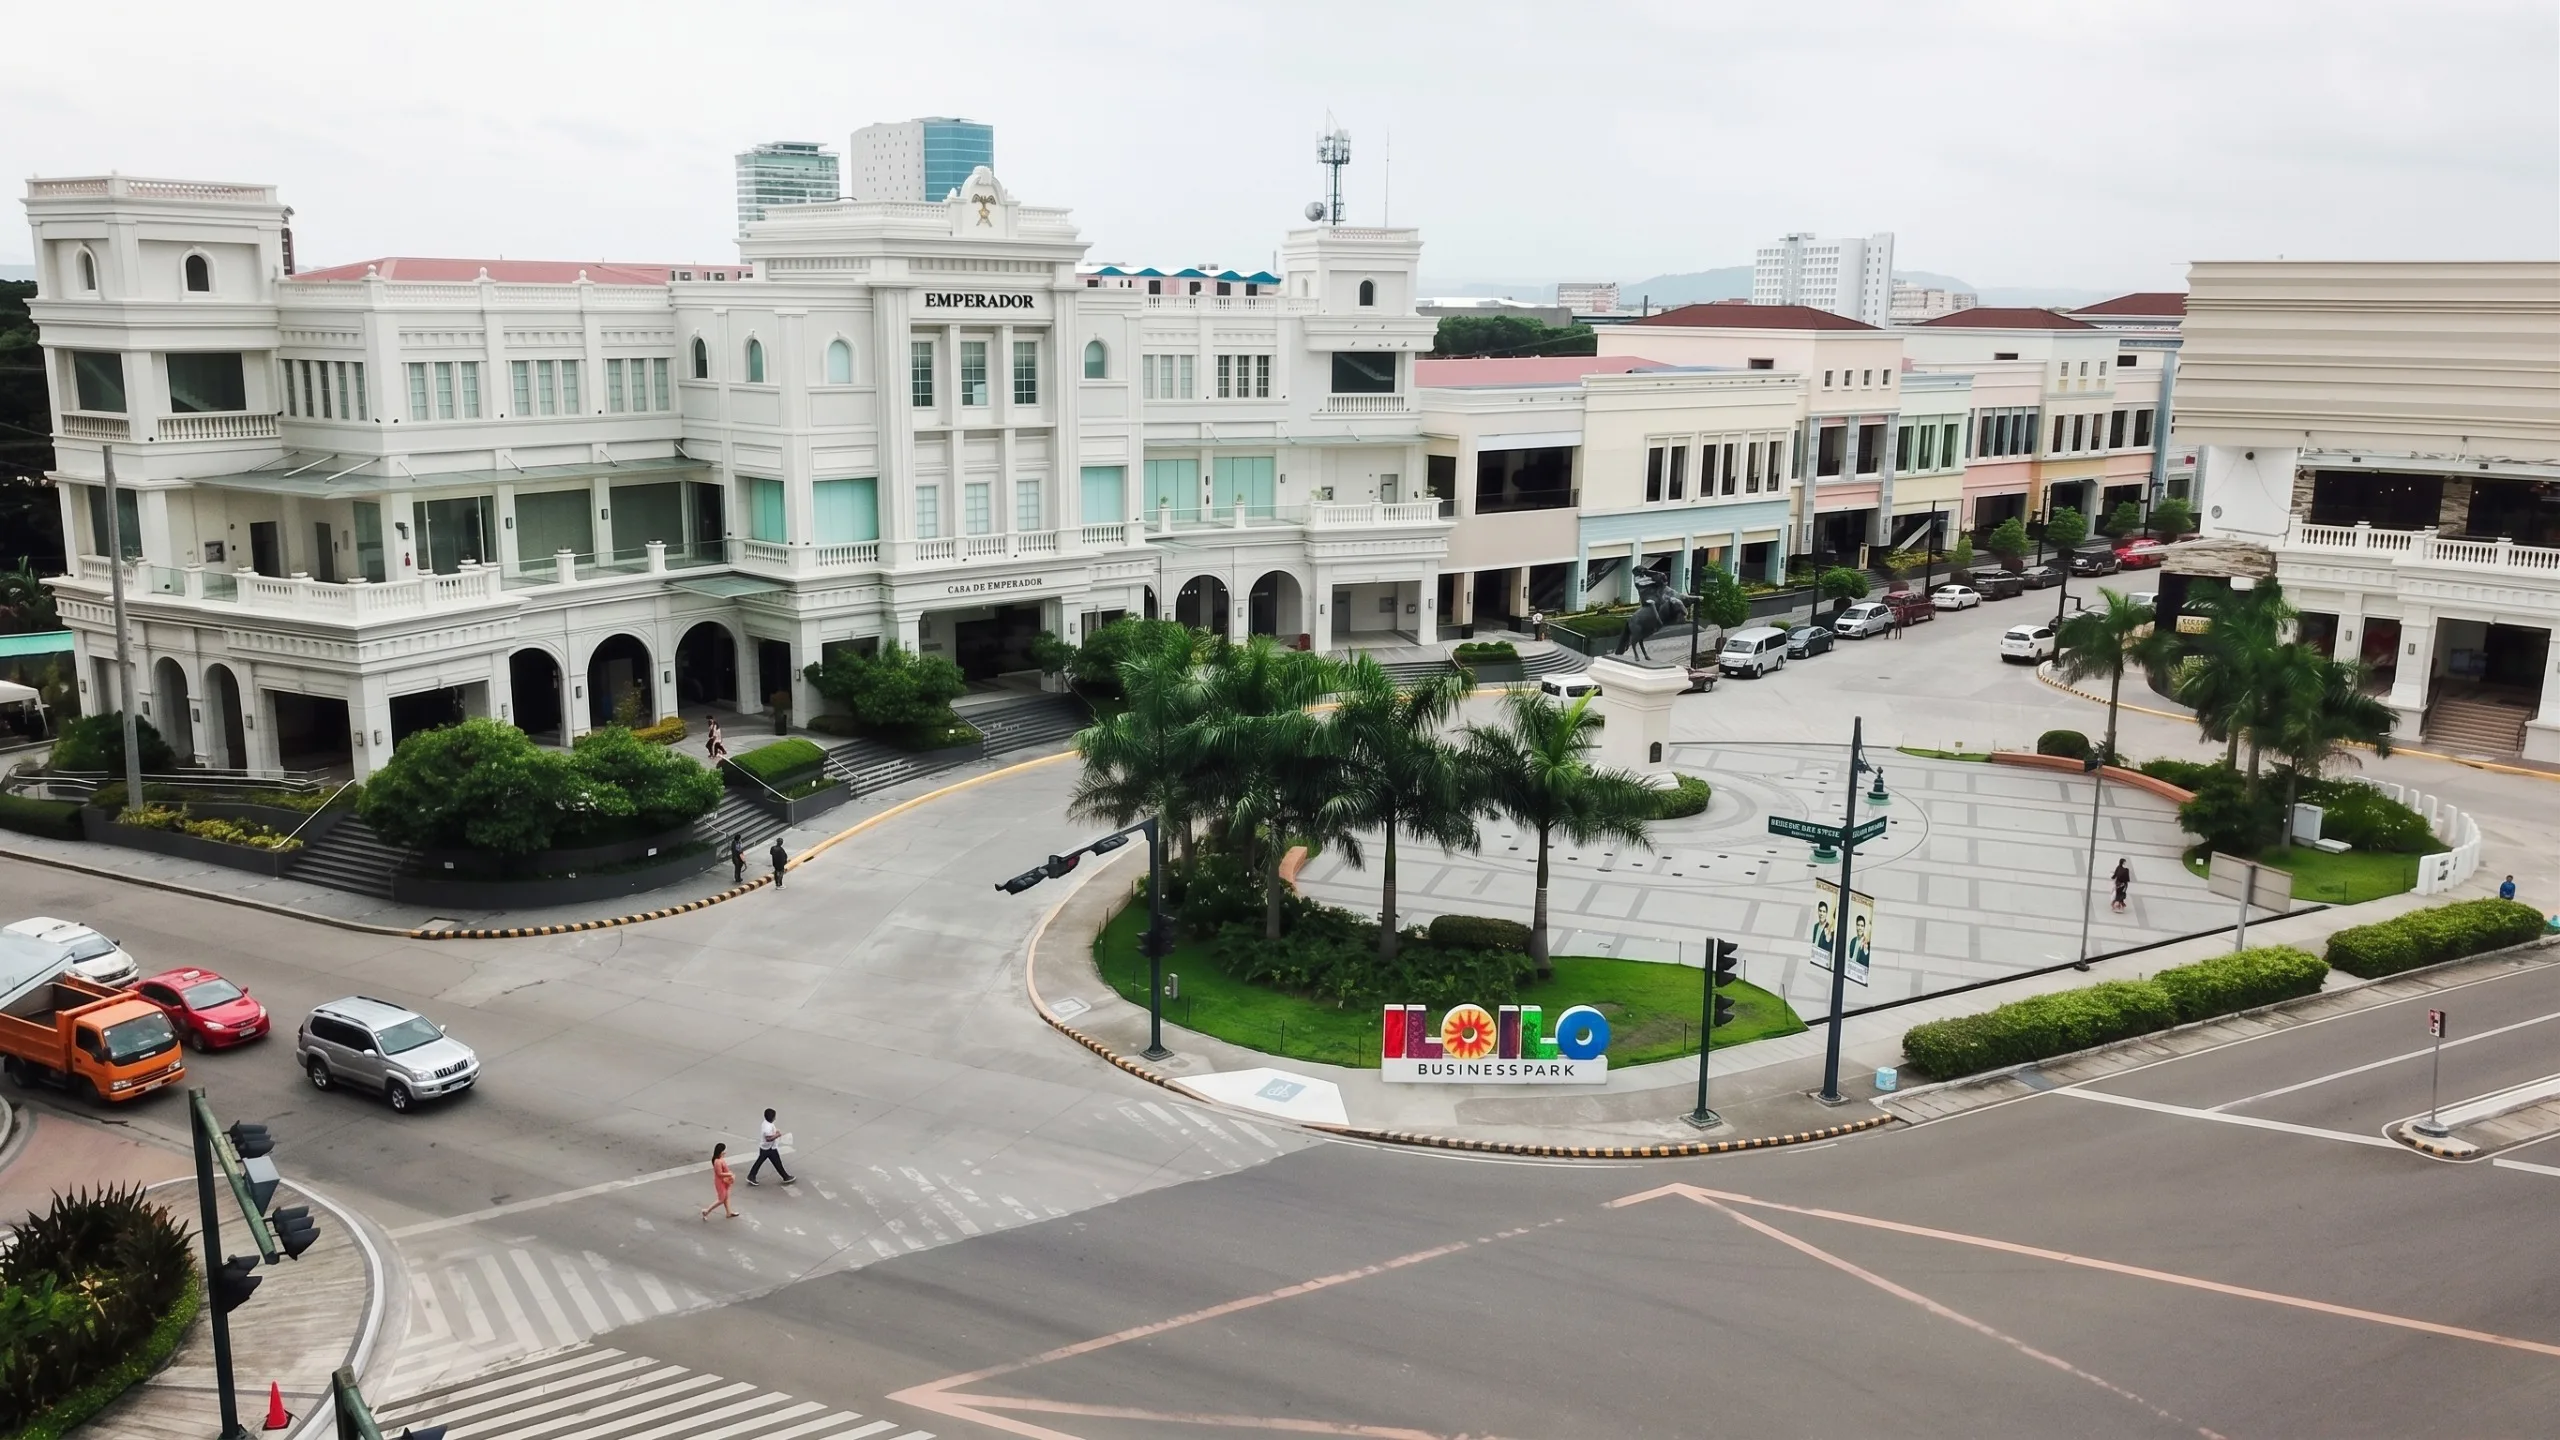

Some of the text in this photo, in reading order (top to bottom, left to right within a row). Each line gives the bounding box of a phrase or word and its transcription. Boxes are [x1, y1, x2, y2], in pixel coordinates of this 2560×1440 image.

[925, 293, 1034, 308] EMPERADOR
[947, 578, 1042, 593] CASA DE EMPERADOR
[1384, 1003, 1609, 1060] ILOILO
[1418, 1063, 1575, 1076] BUSINESS PARK
